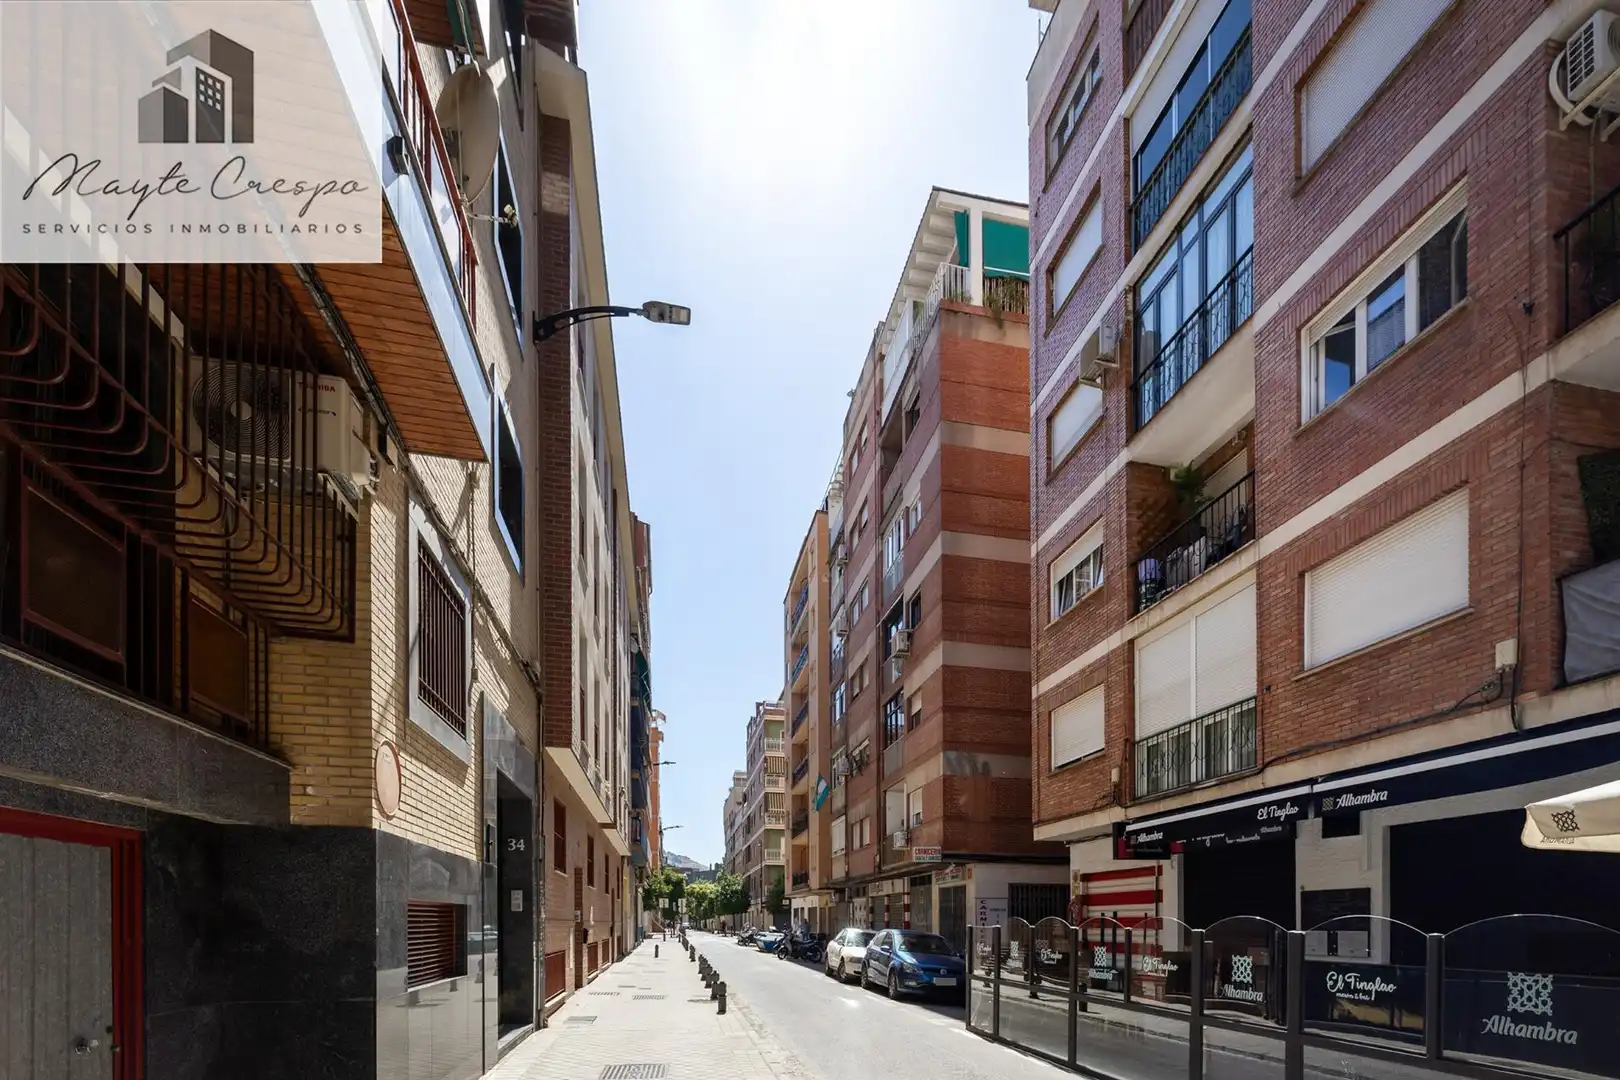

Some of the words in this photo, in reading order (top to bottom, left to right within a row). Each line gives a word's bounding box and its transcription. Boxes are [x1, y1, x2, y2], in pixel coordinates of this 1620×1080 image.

[1336, 790, 1389, 808] Alhambra
[1257, 808, 1269, 820] El
[1269, 802, 1299, 821] Tinglao
[507, 838, 526, 851] 34
[1136, 830, 1164, 844] Alhambra
[1221, 984, 1264, 1001] Alhambra
[1326, 971, 1344, 992] El
[1345, 972, 1397, 1001] Tinglao
[1482, 1015, 1578, 1045] Alhambra
